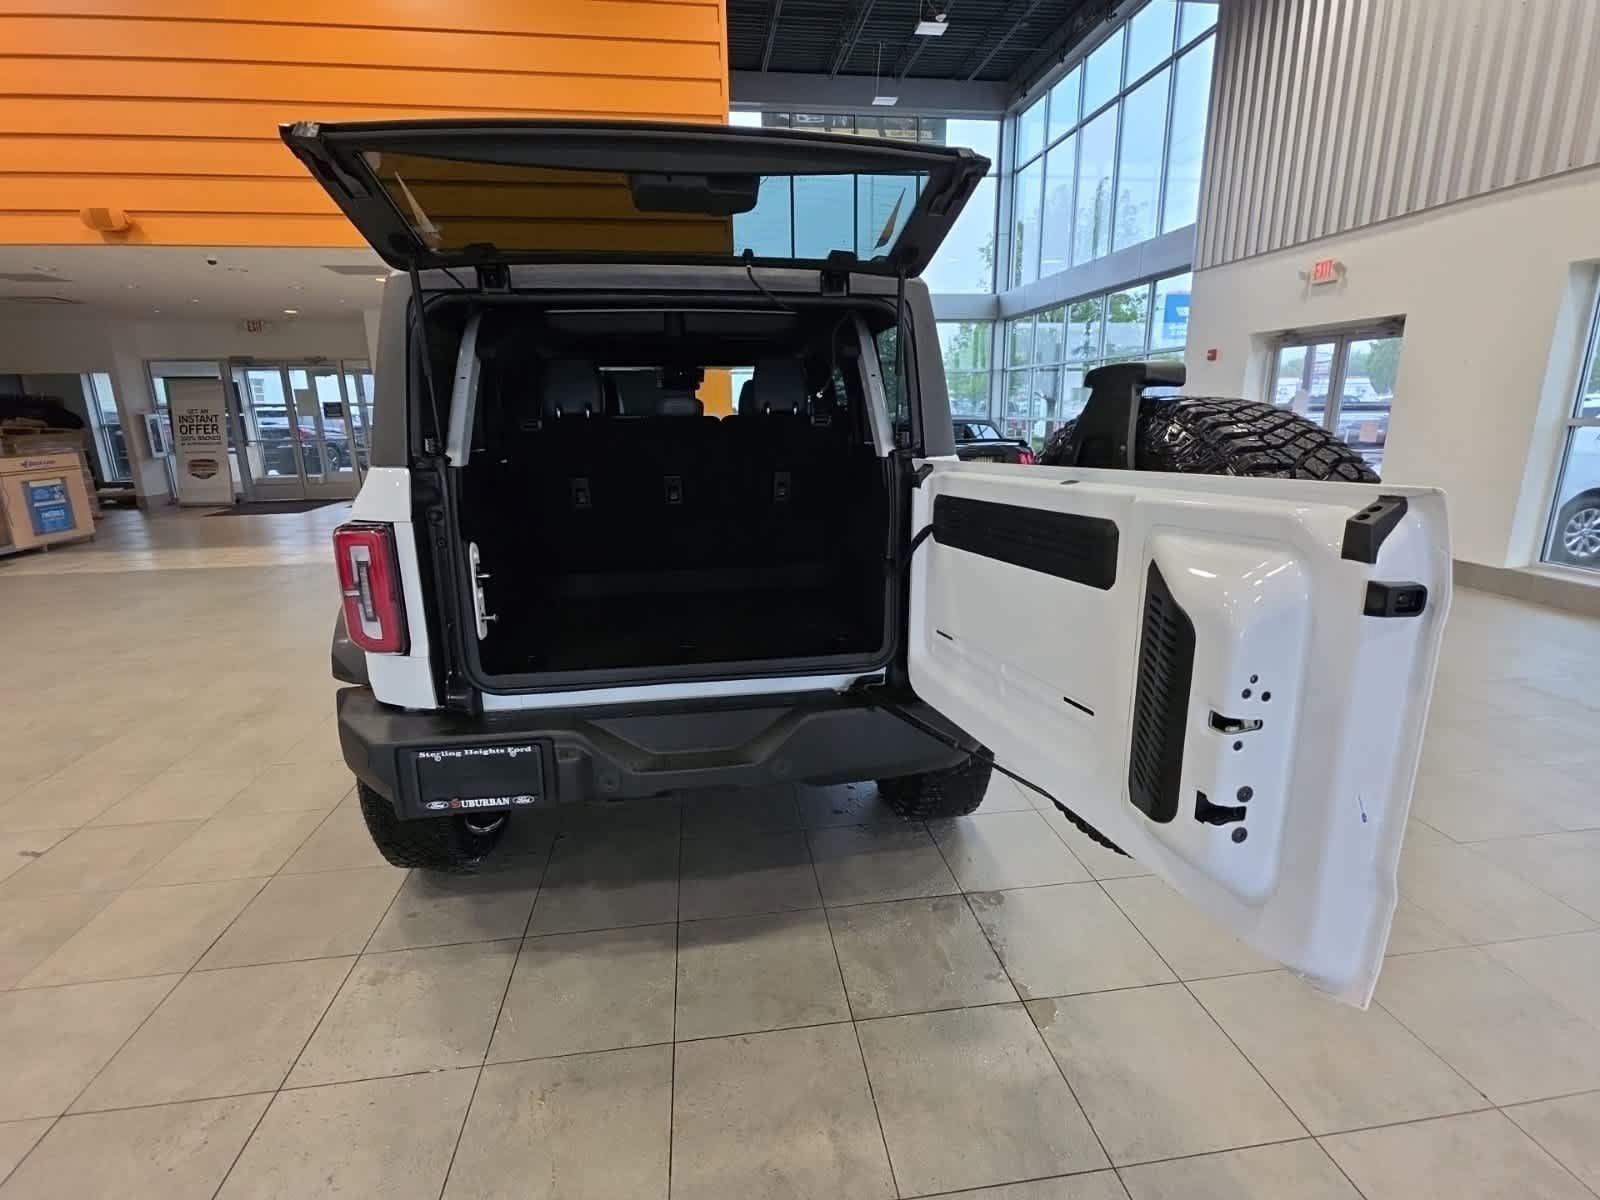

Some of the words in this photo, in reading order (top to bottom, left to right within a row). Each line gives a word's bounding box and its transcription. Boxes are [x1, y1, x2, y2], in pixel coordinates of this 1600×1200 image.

[1314, 260, 1335, 281] EXIT
[178, 415, 219, 423] INSTANT
[179, 423, 220, 435] OFFER
[463, 747, 505, 756] Heights
[507, 746, 532, 754] Ford
[450, 798, 511, 809] SUBURBAN
